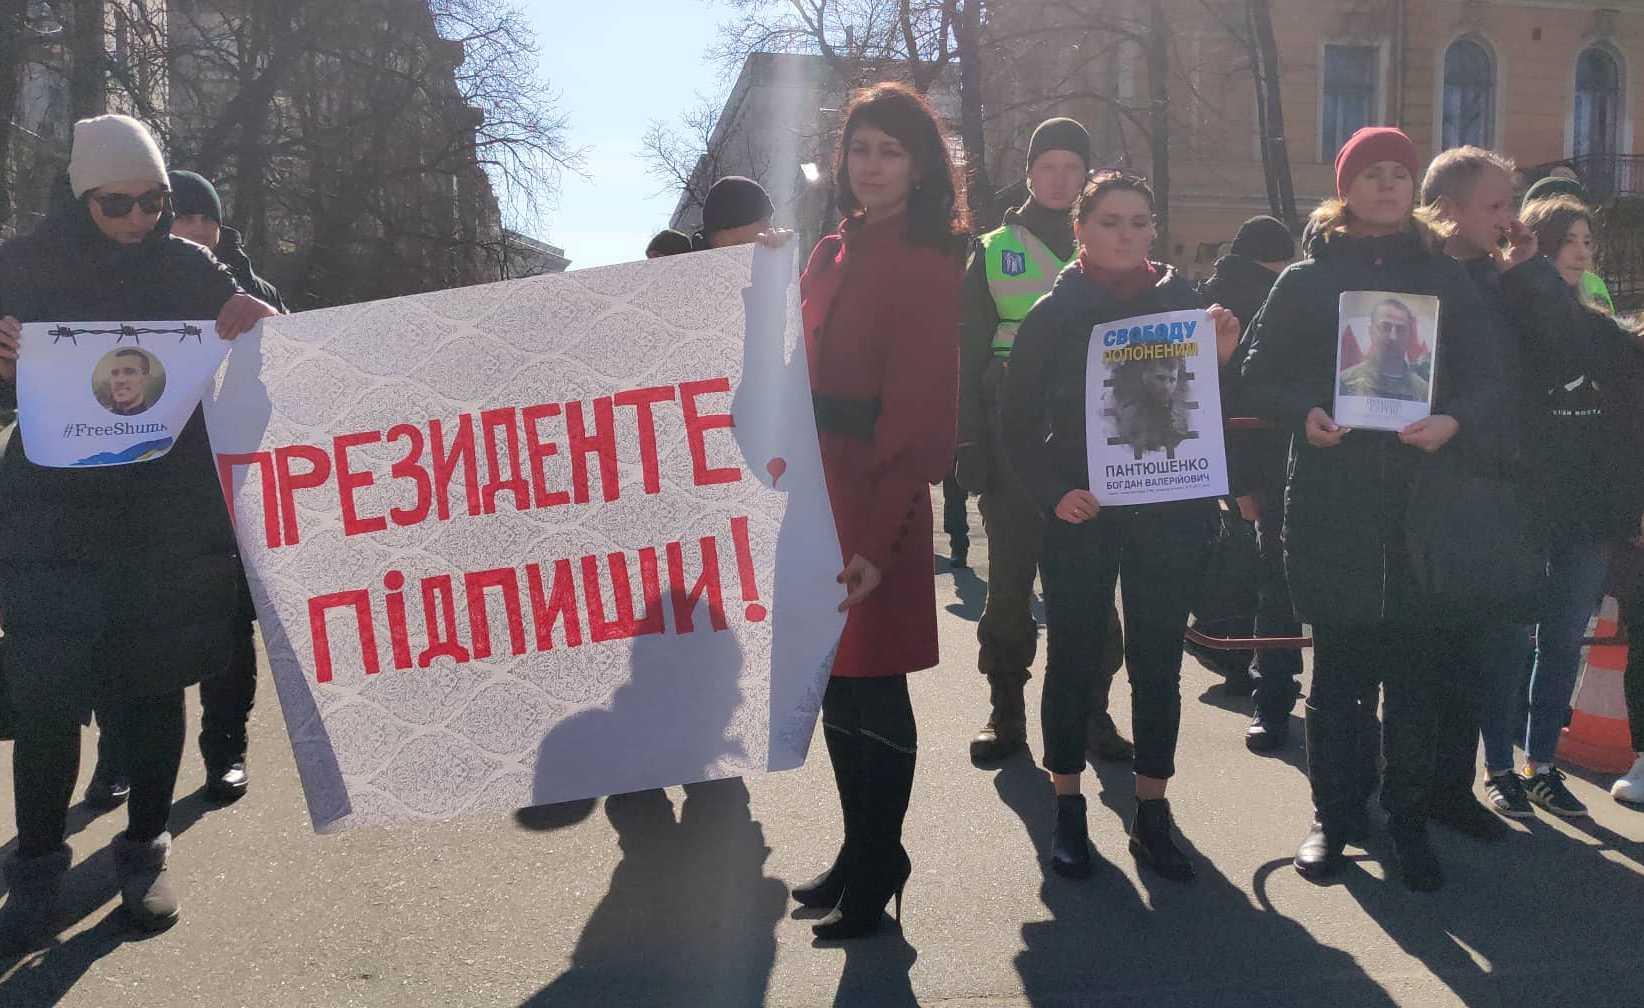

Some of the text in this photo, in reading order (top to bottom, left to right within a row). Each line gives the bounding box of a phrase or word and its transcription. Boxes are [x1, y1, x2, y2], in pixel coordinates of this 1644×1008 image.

[1103, 320, 1197, 347] СВОБОДУ
[1105, 457, 1209, 478] ПАНТЮШЕНКО
[1106, 479, 1143, 490] БОГДАН
[1145, 472, 1210, 488] ВАЛЕРІЙОВИЧ
